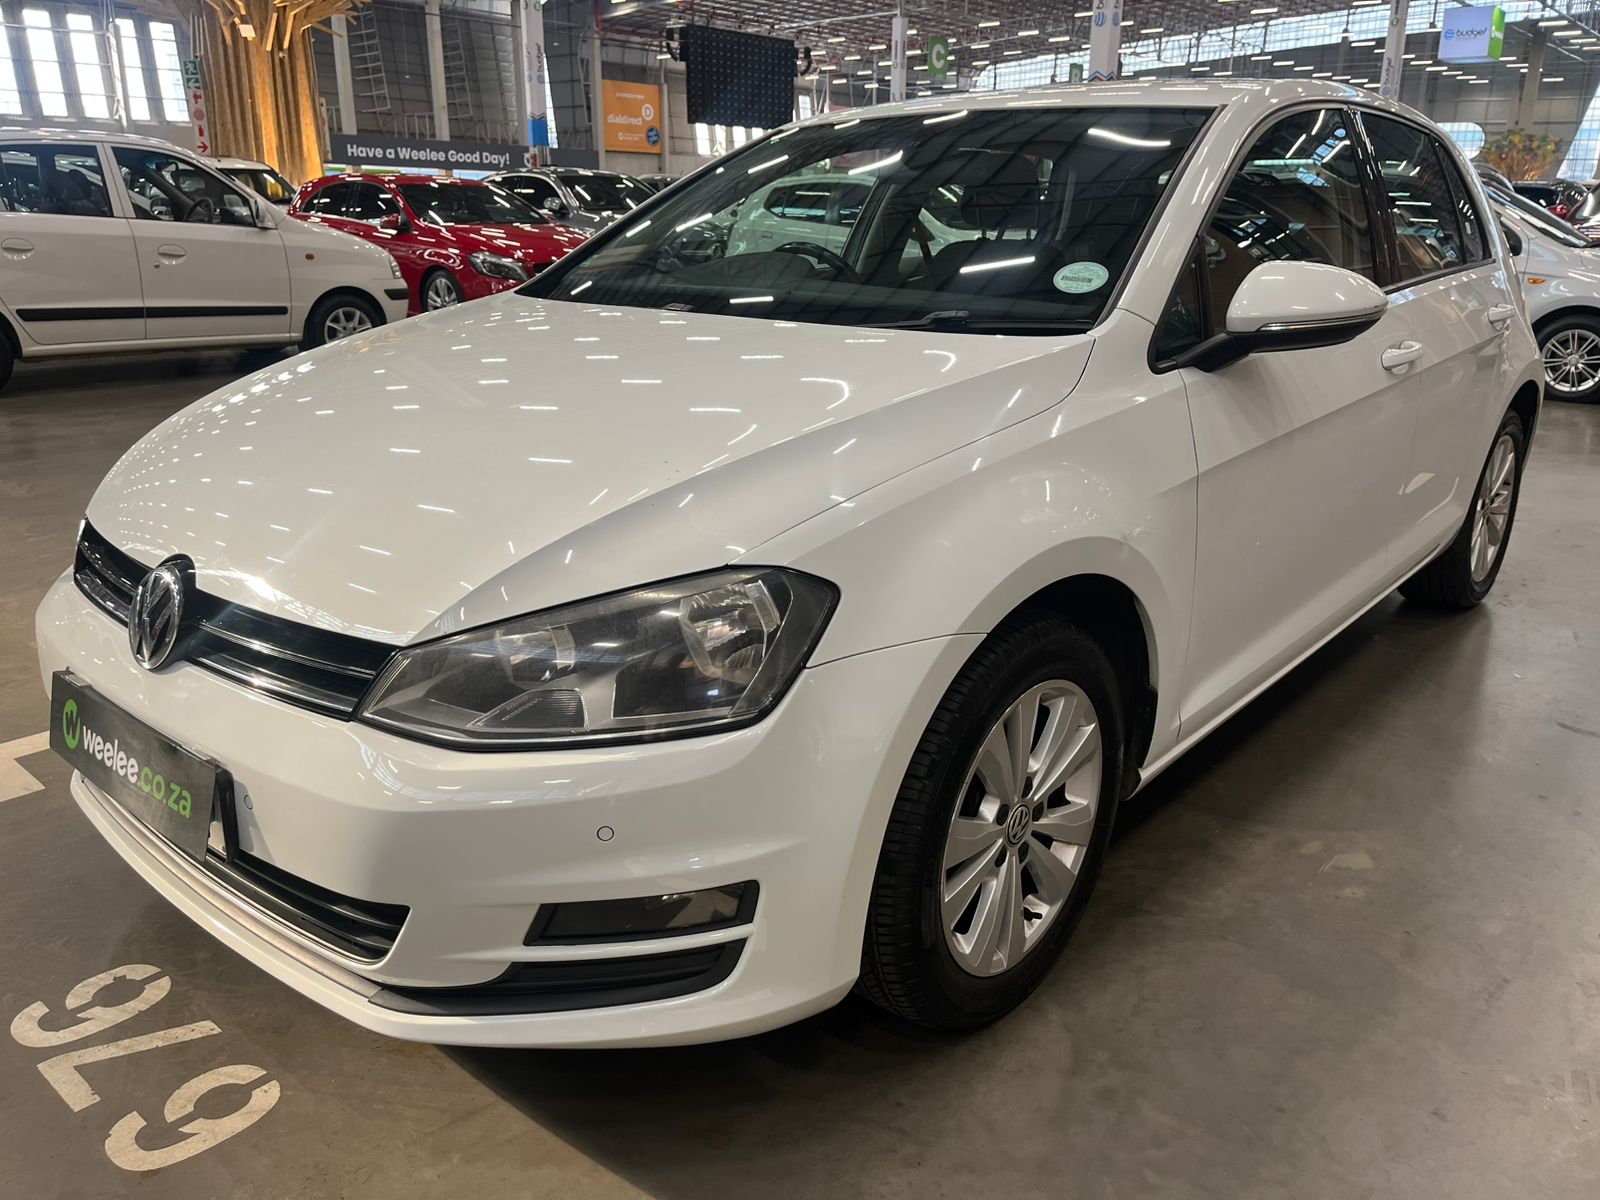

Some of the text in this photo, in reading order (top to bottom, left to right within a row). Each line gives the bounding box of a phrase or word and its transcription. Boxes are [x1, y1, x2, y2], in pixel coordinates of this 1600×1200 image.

[1456, 27, 1487, 38] budget
[932, 44, 945, 69] C
[346, 143, 510, 168] Have a Weelee Good Day!
[82, 725, 193, 818] weelee.co.za
